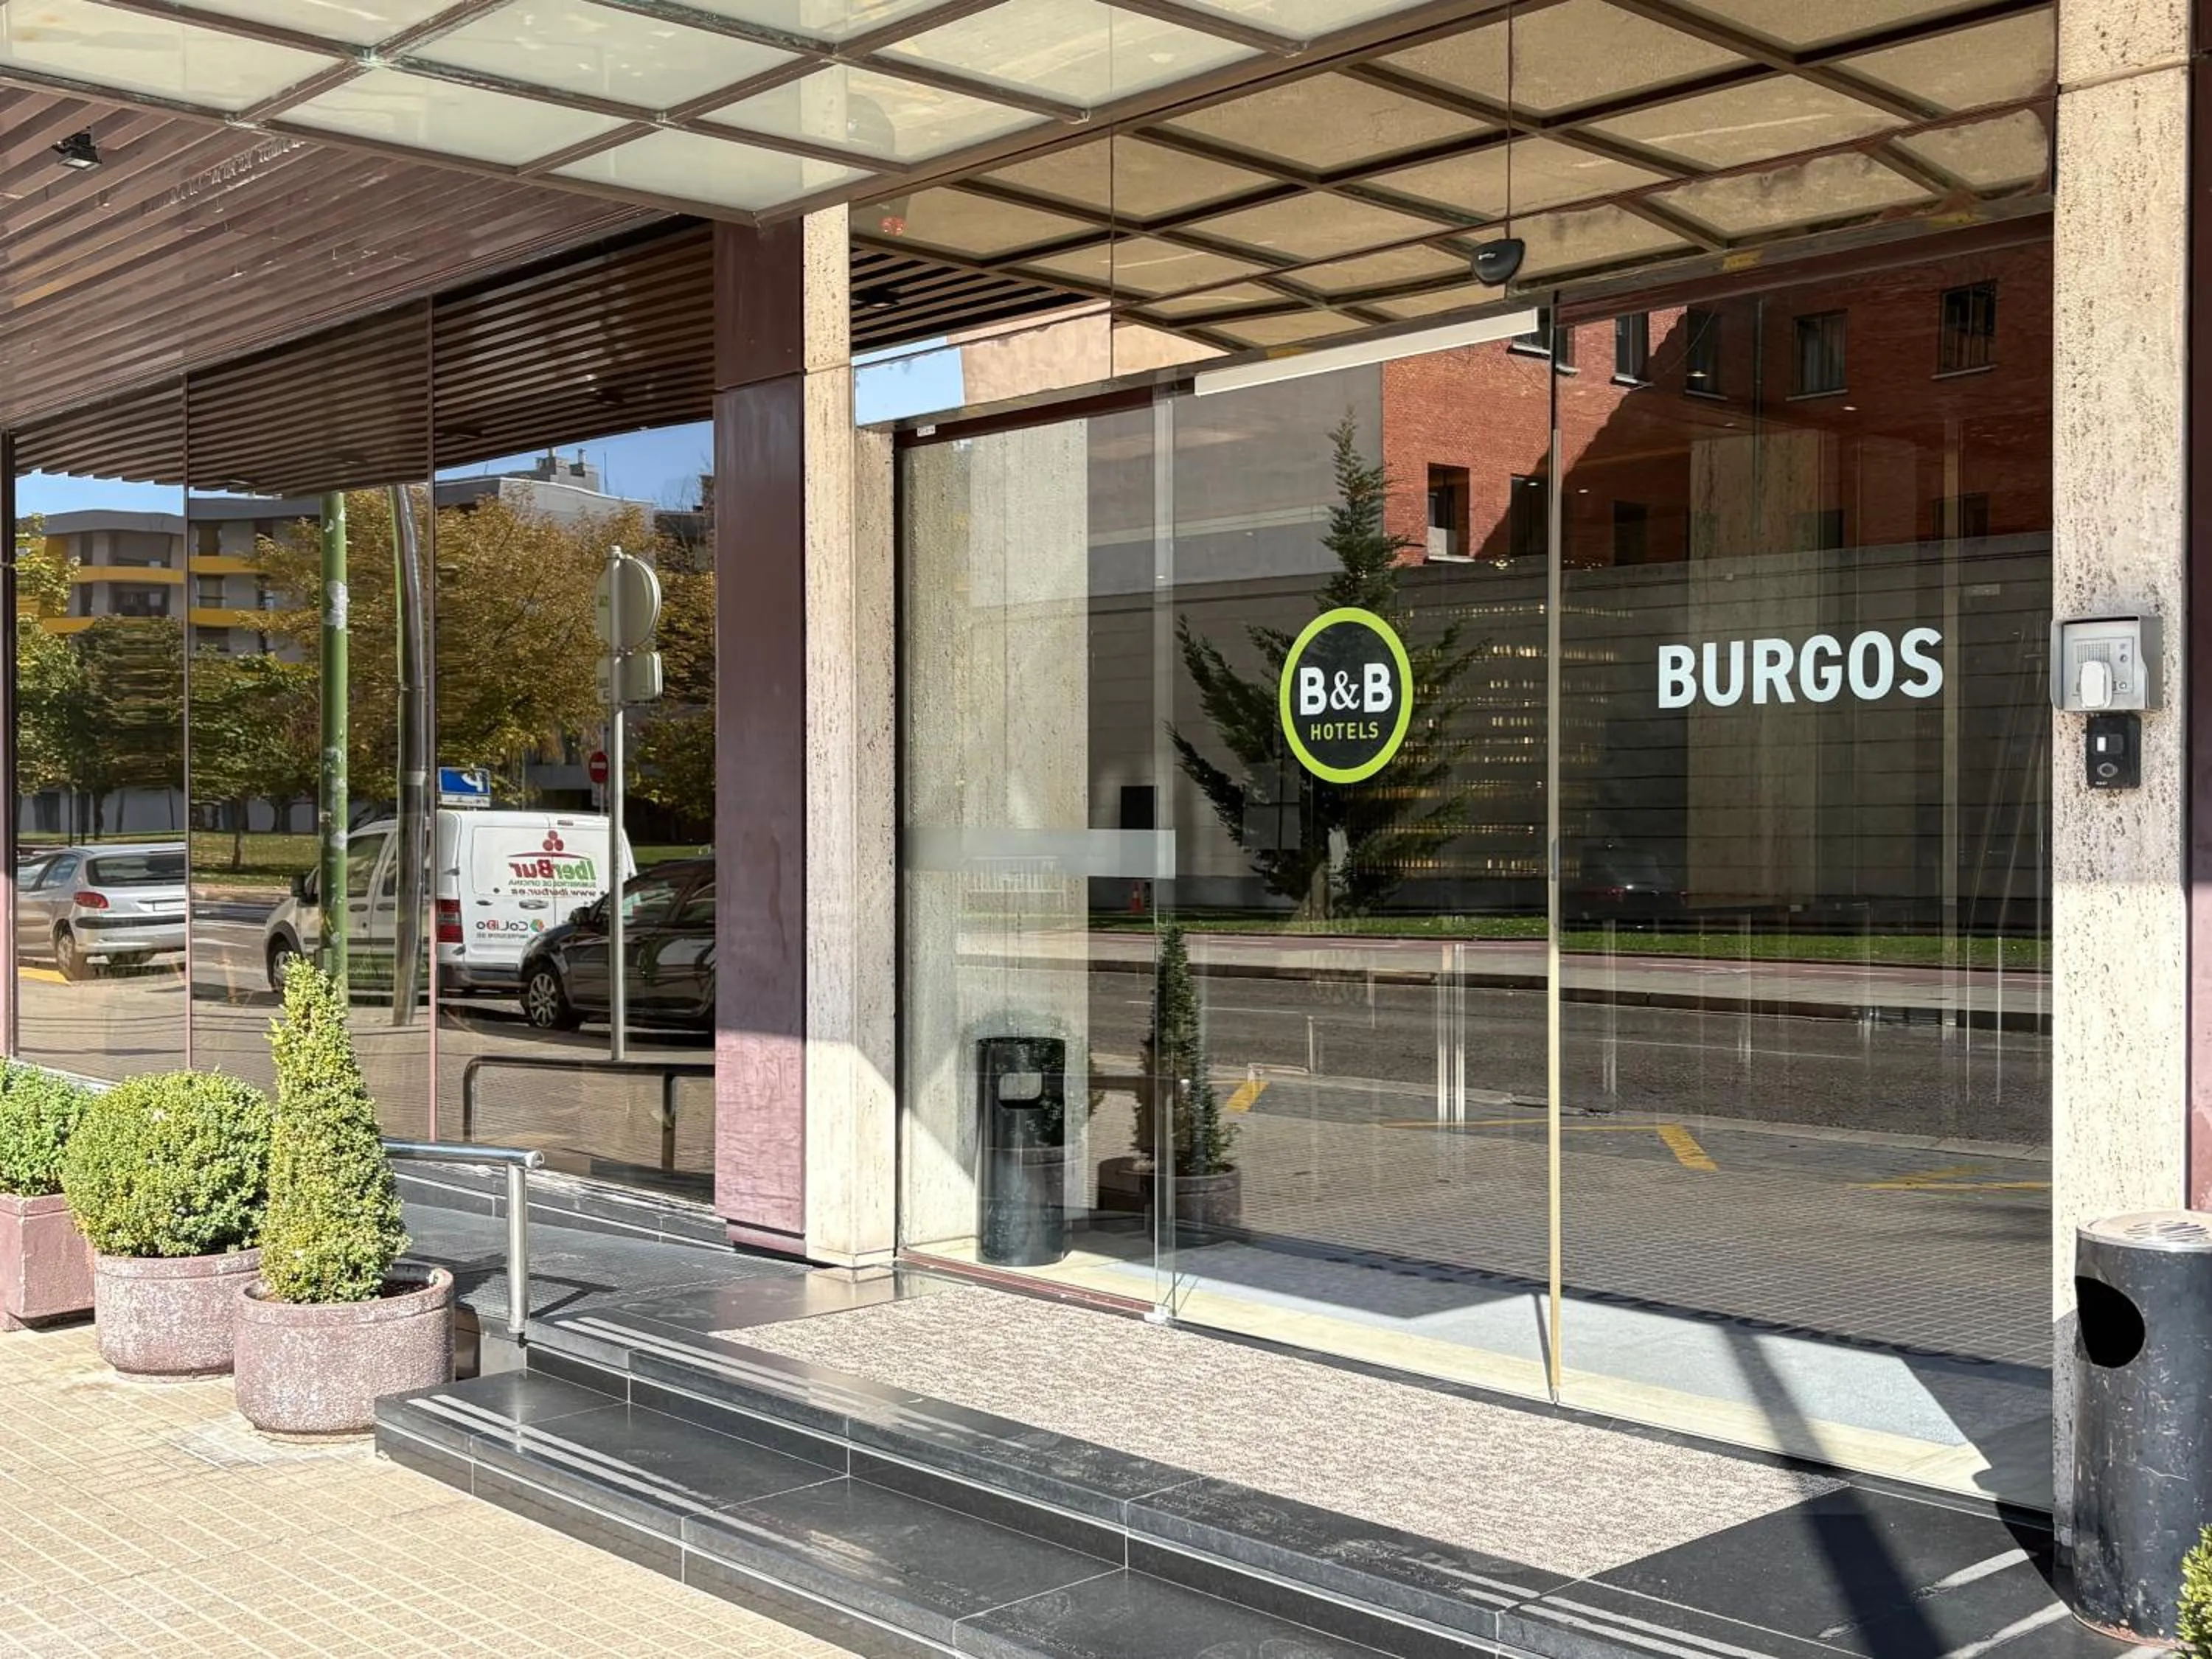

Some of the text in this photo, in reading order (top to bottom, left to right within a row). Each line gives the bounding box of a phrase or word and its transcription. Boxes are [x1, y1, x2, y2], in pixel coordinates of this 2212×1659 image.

[1299, 663, 1394, 715] B&B
[1658, 627, 1944, 709] BURGOS
[1310, 722, 1380, 740] HOTELS
